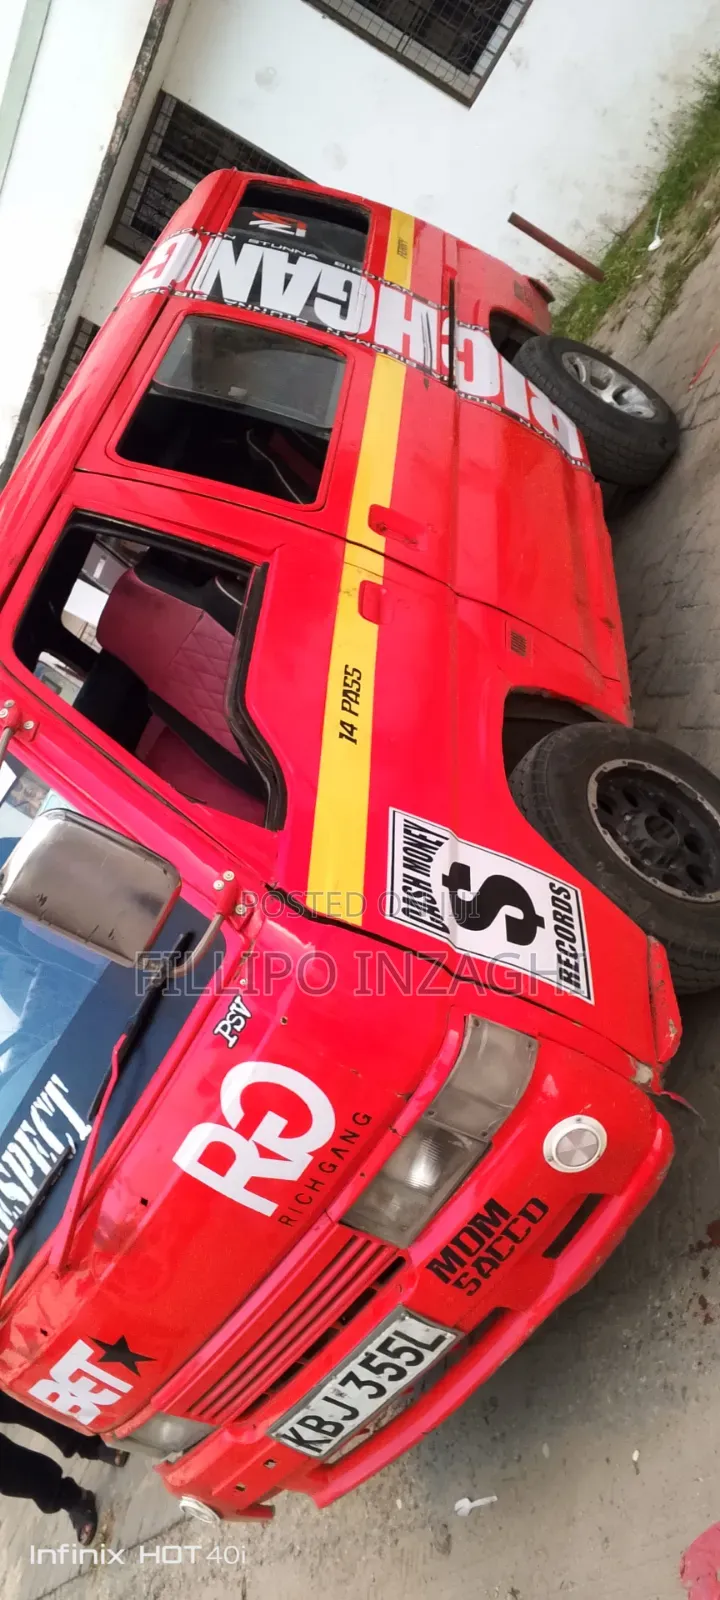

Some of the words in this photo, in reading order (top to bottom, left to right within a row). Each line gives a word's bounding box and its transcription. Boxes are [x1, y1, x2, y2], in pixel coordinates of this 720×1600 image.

[248, 238, 319, 259] STUNNA
[334, 260, 413, 297] BIRDMAN
[223, 298, 309, 326] STUNNA
[325, 326, 417, 368] BIRDMAN
[431, 371, 502, 412] STUNA
[341, 664, 362, 717] PASS
[338, 719, 358, 745] 14
[402, 818, 450, 877] MONEY
[401, 873, 450, 935] CASH
[548, 881, 581, 989] RECORDS
[213, 994, 252, 1048] PSV
[278, 1111, 373, 1227] RICHGANG
[28, 1338, 134, 1426] BET
[281, 1396, 360, 1453] KBJ
[338, 1330, 448, 1400] 355L
